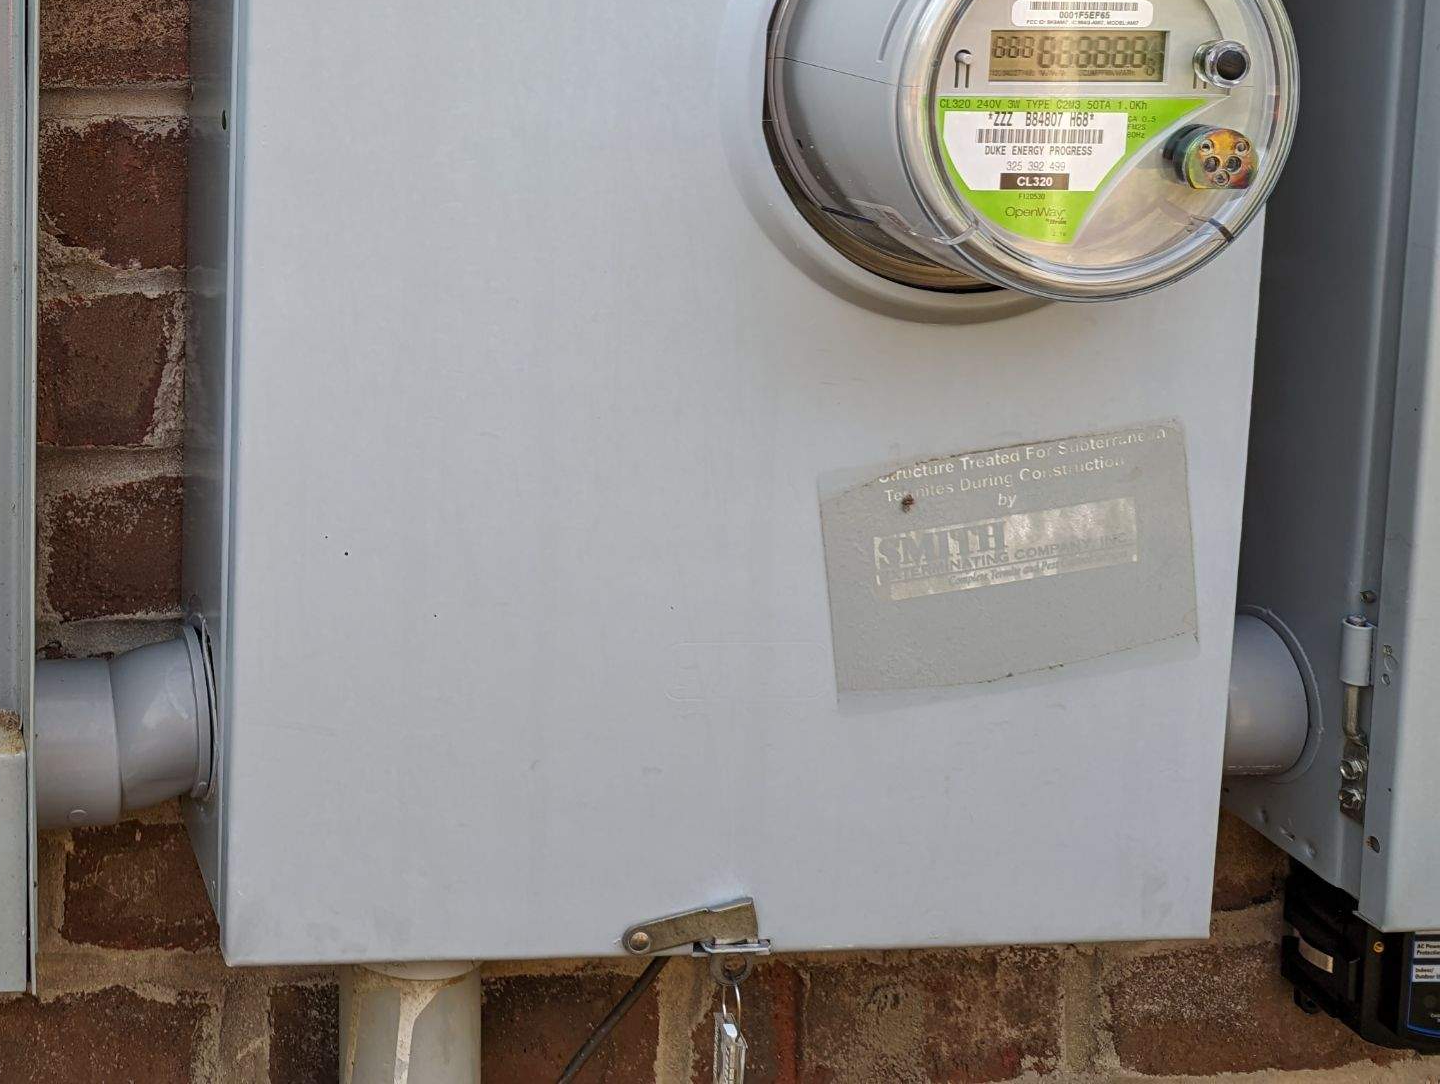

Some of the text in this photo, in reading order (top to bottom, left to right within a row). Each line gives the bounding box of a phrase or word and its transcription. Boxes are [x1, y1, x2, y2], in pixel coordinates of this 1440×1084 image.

[940, 99, 971, 108] CL320
[977, 100, 1001, 108] 240V
[1008, 100, 1020, 108] 3W
[1026, 100, 1050, 108] TYPE
[1087, 100, 1111, 109] 50TA
[1025, 112, 1063, 127] B84807
[985, 146, 1092, 156] DUKE ENERGY PROGRESS
[1006, 161, 1066, 171] 325 392 499
[1017, 176, 1053, 187] CL320
[1005, 206, 1066, 220] OpenWay
[959, 451, 1020, 470] Treated
[1025, 446, 1052, 460] For
[884, 483, 954, 502] Temites
[960, 473, 1013, 491] During
[998, 493, 1016, 508] by
